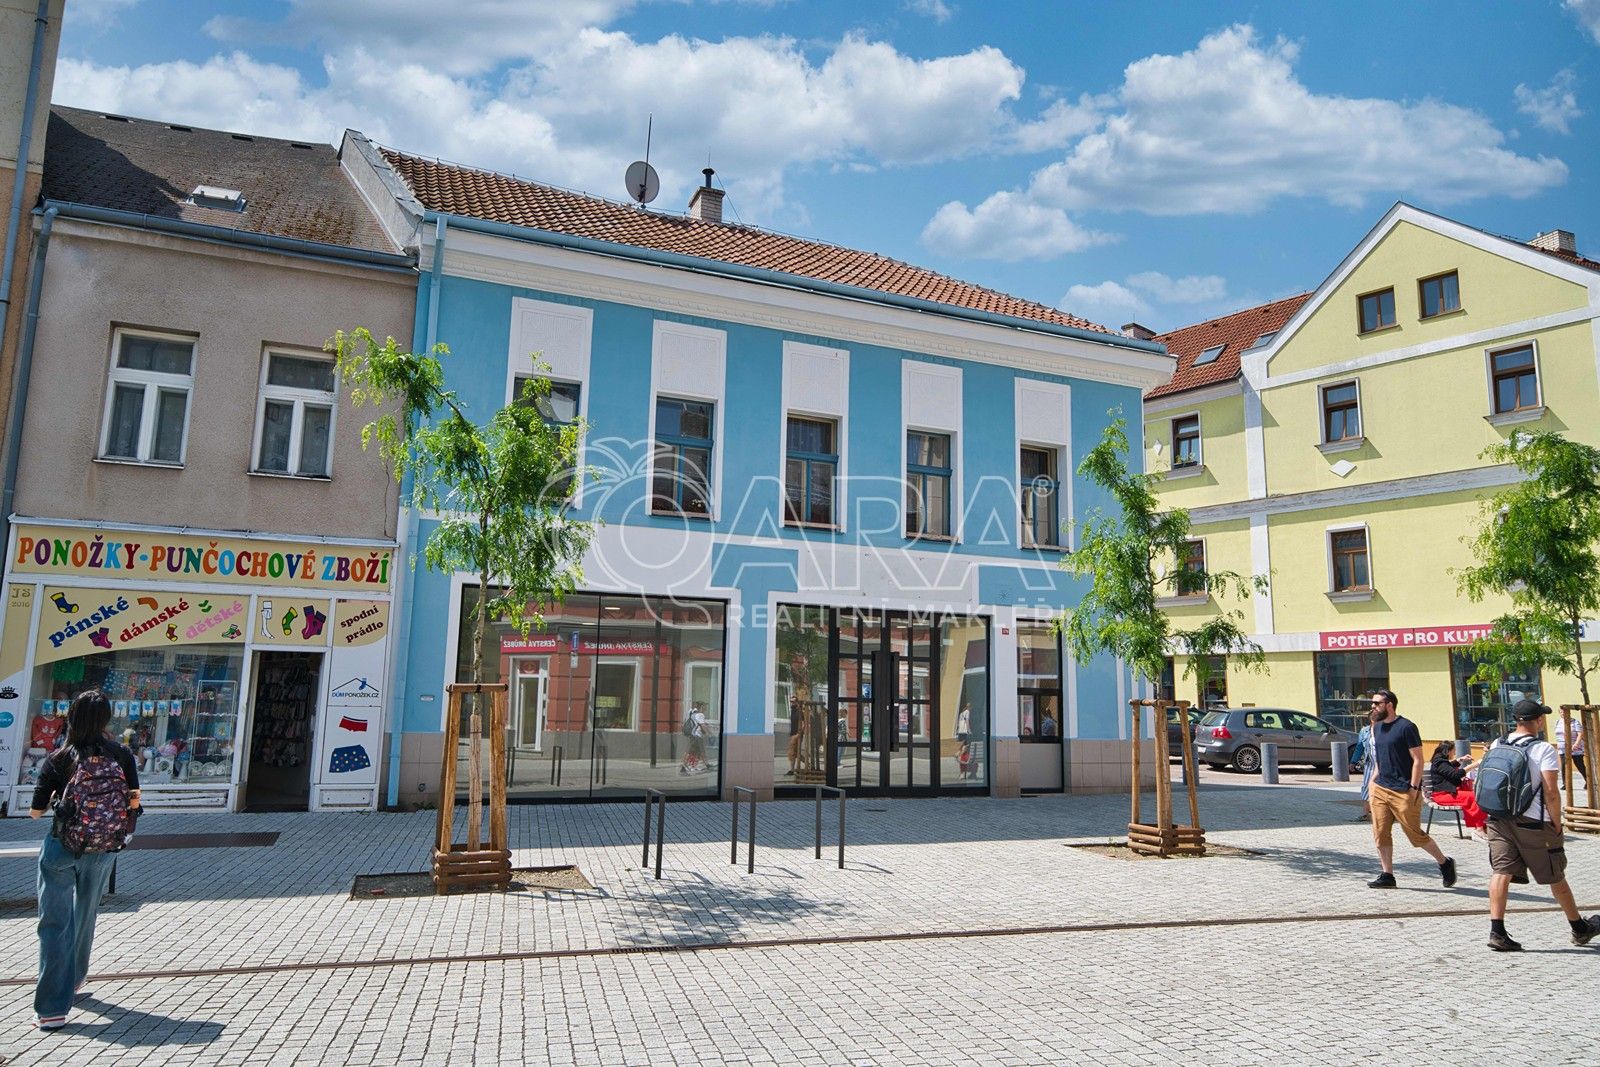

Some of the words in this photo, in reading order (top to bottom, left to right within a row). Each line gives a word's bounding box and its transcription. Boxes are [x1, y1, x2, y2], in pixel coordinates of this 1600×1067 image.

[321, 551, 389, 584] ZBOŽÍ
[48, 596, 130, 648] pánské
[119, 597, 190, 642] dámské
[185, 600, 244, 640] dětské
[340, 605, 380, 629] spodní
[345, 620, 384, 643] prádlo
[1327, 632, 1398, 647] POTŘEBY
[1403, 631, 1439, 645] PRO
[1443, 629, 1494, 643] KUTI
